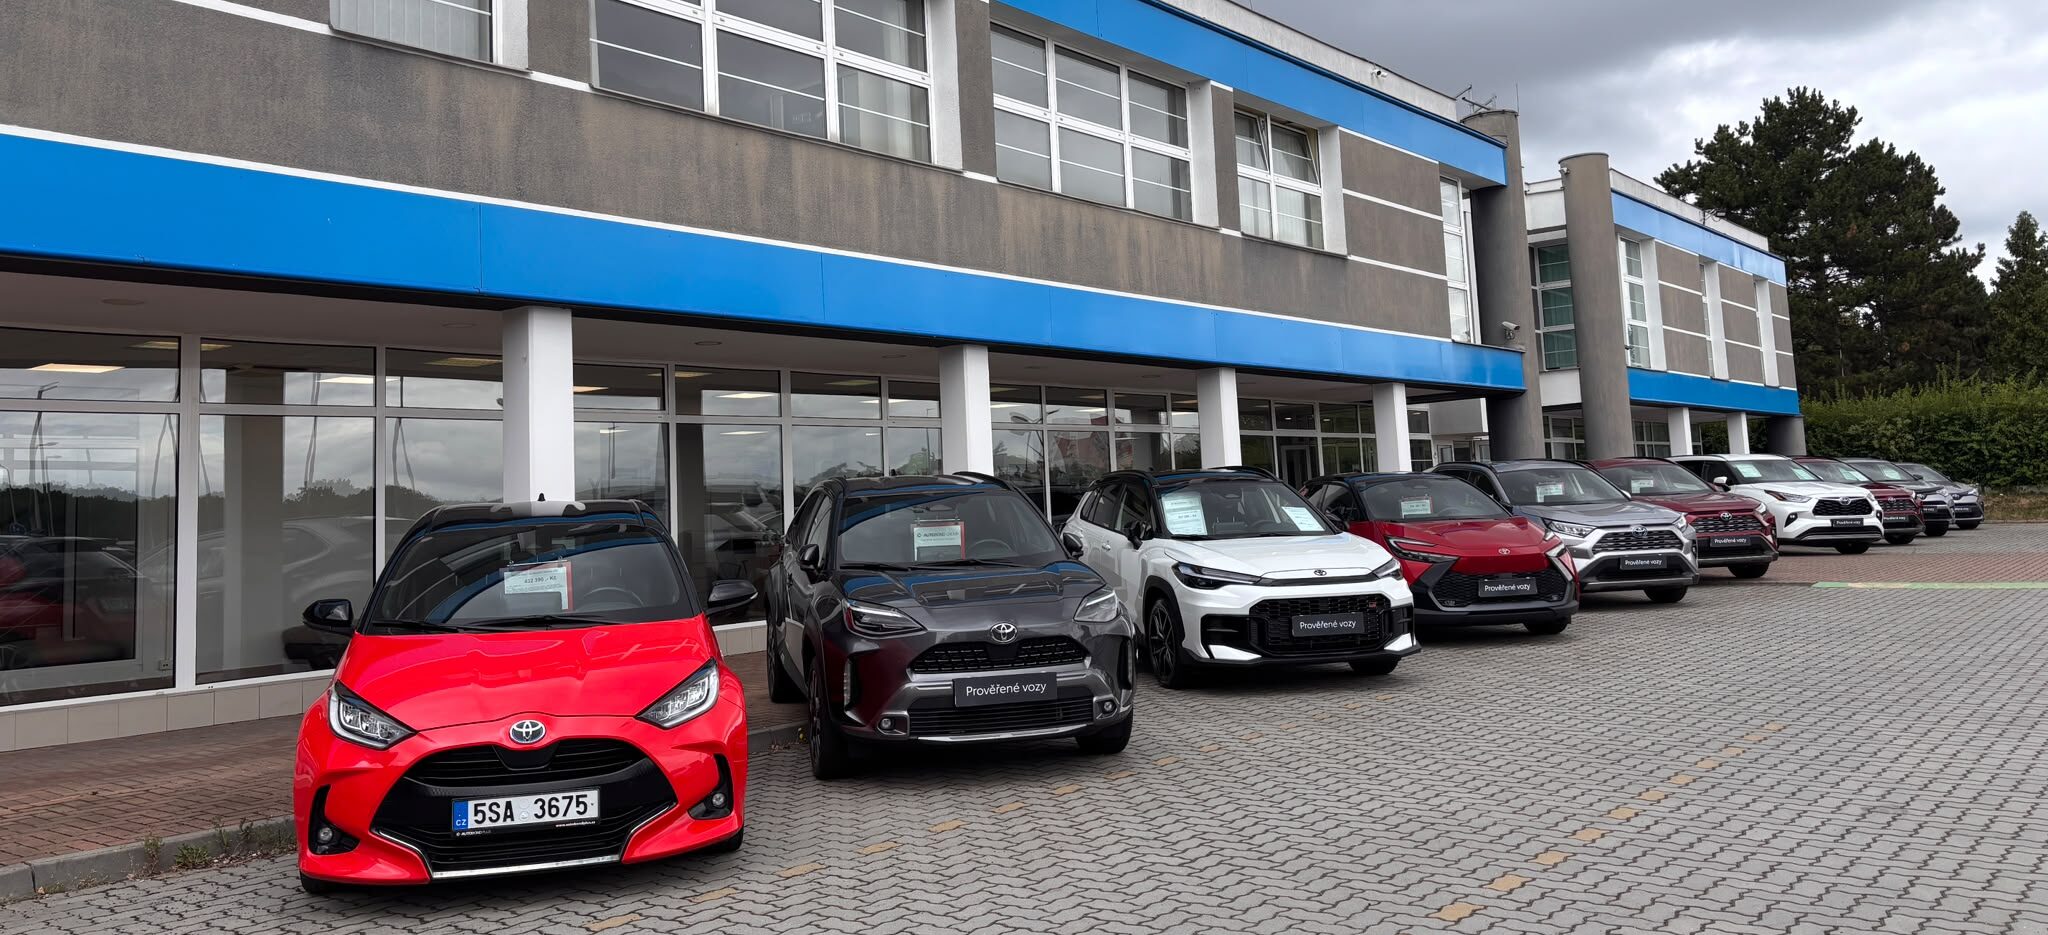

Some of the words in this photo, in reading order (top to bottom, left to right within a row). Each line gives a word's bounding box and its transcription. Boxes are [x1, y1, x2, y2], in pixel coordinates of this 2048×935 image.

[1516, 583, 1530, 591] vozy
[1300, 620, 1337, 629] Prověřené
[1339, 620, 1356, 628] vozy
[966, 682, 1020, 697] Prověřené
[1022, 683, 1047, 693] vozy
[473, 800, 515, 824] 5SA
[533, 794, 588, 819] 3675
[455, 819, 467, 827] CZ
